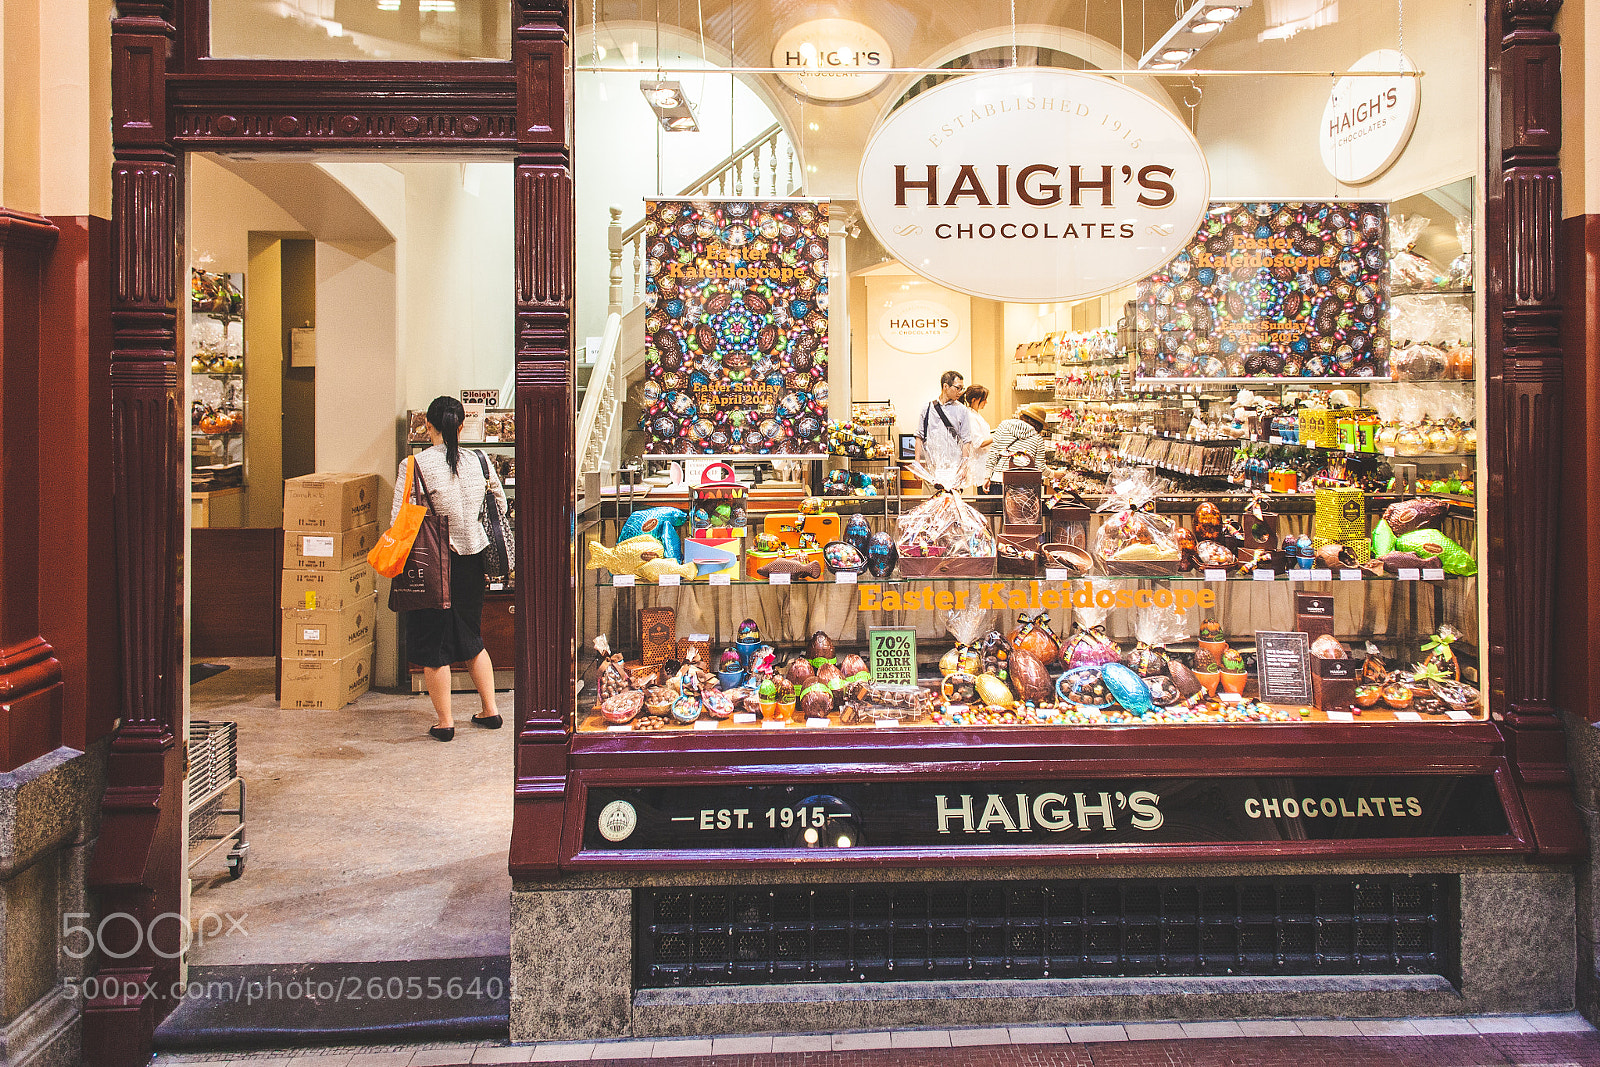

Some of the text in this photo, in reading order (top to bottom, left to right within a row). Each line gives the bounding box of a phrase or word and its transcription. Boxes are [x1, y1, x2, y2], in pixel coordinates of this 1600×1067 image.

[786, 51, 880, 66] HIGH'S
[1329, 87, 1397, 138] HAIGH'S
[928, 97, 1143, 150] ESTABLISHED 1915
[1338, 118, 1387, 147] CHOCOLATES
[894, 163, 1177, 209] HAIGH'S
[935, 223, 1135, 239] CHOCOLATES
[1232, 234, 1295, 250] Easter
[705, 244, 769, 260] Easter
[1198, 252, 1331, 271] Kaleidoscope
[669, 262, 805, 283] Kaleidoscope
[890, 318, 949, 329] HAIGH'S
[1221, 319, 1308, 334] Easter Sunday
[1228, 332, 1300, 345] 5 April 2015
[692, 381, 781, 395] Easter Sunday
[700, 394, 773, 407] 5 April 2015
[857, 581, 1216, 615] Easter Kaleidoscope
[875, 635, 911, 650] 70%
[876, 649, 911, 658] COCOA
[876, 657, 912, 667] DARK
[935, 790, 1164, 834] HAIGH'S
[1244, 796, 1423, 819] CHOCOLATES
[700, 806, 825, 830] EST. 1915
